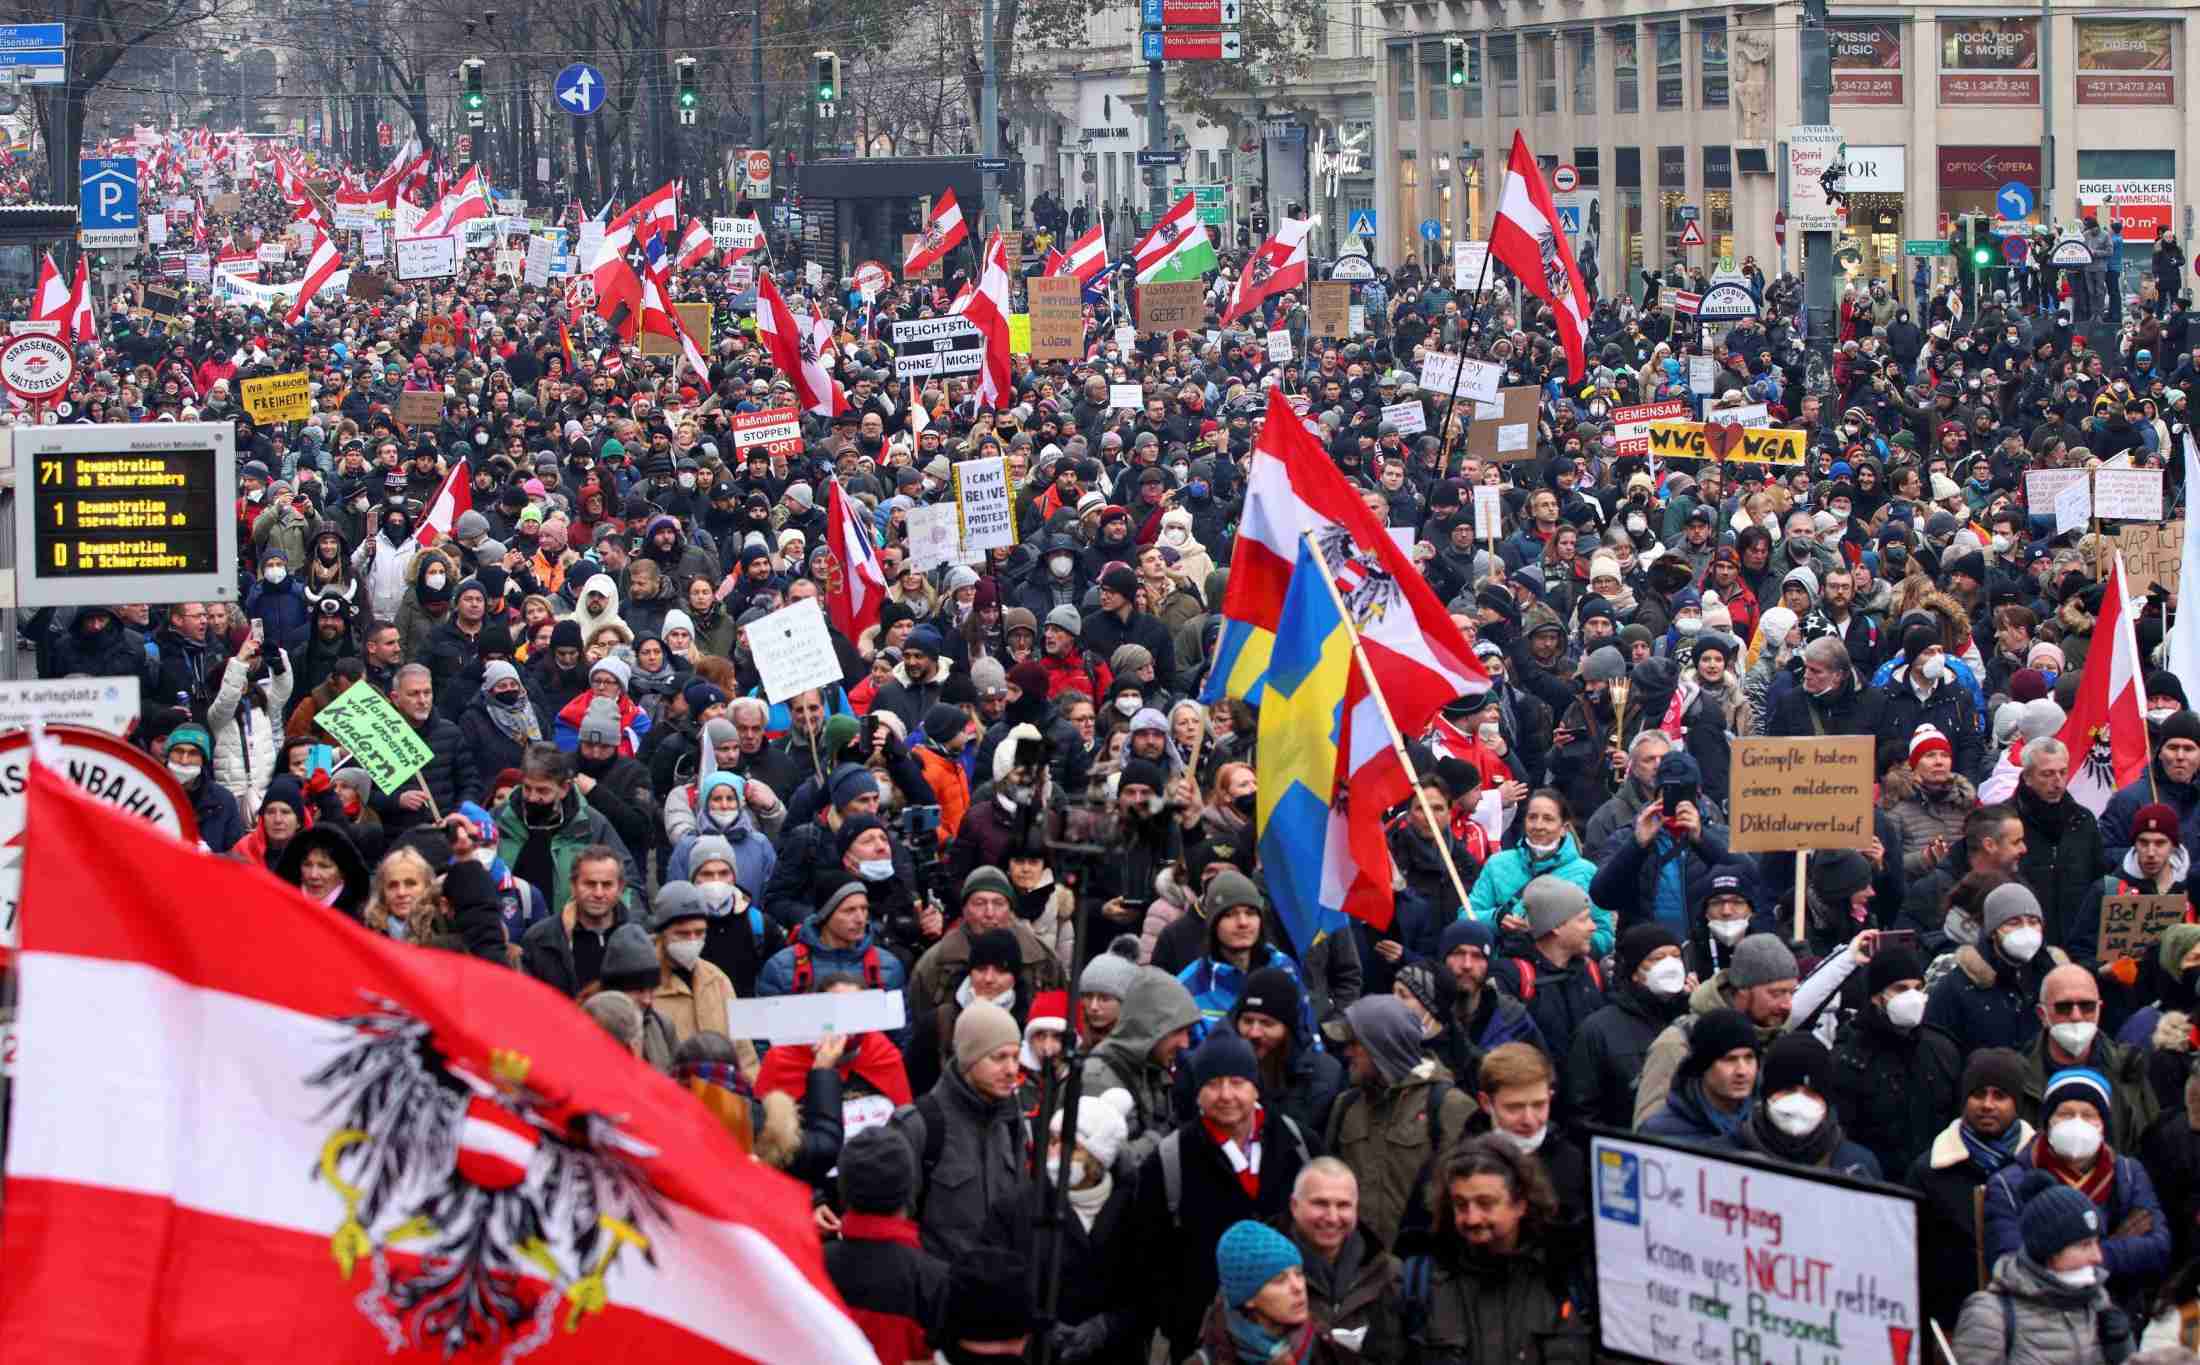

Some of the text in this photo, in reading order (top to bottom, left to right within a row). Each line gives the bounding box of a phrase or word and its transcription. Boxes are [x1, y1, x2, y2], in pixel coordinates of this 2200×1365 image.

[1976, 44, 2014, 55] MORE
[2103, 40, 2145, 50] OPERA
[1792, 147, 1822, 161] Demi
[1848, 161, 1880, 177] OR
[1947, 161, 2033, 172] OPTIC OPERA
[100, 182, 122, 217] P
[714, 236, 753, 247] FREIHEIT
[1705, 304, 1752, 312] HALTESTELLE
[6, 340, 67, 362] STRASSENBAHN
[898, 359, 933, 371] OHNE
[8, 369, 65, 390] HALTESTELLE
[1614, 403, 1681, 422] GEMEINSAM
[743, 427, 791, 442] STOPPEN
[41, 461, 63, 485] 71
[77, 475, 92, 487] ab
[53, 502, 64, 526] 1
[171, 512, 186, 525] ab
[79, 556, 93, 568] ab
[20, 688, 99, 704] Karlsplatz
[323, 706, 396, 779] Kindern
[1814, 748, 1857, 765] haben
[1742, 777, 1859, 798] einen milderen
[1740, 812, 1864, 835] Diktaturverlauf
[1643, 1158, 1685, 1208] Die
[1699, 1167, 1783, 1247] Impfung
[1645, 1220, 1695, 1273] kann
[1702, 1256, 1741, 1287] uns
[1744, 1247, 1833, 1307] NICHT
[1748, 1291, 1843, 1349] Personal
